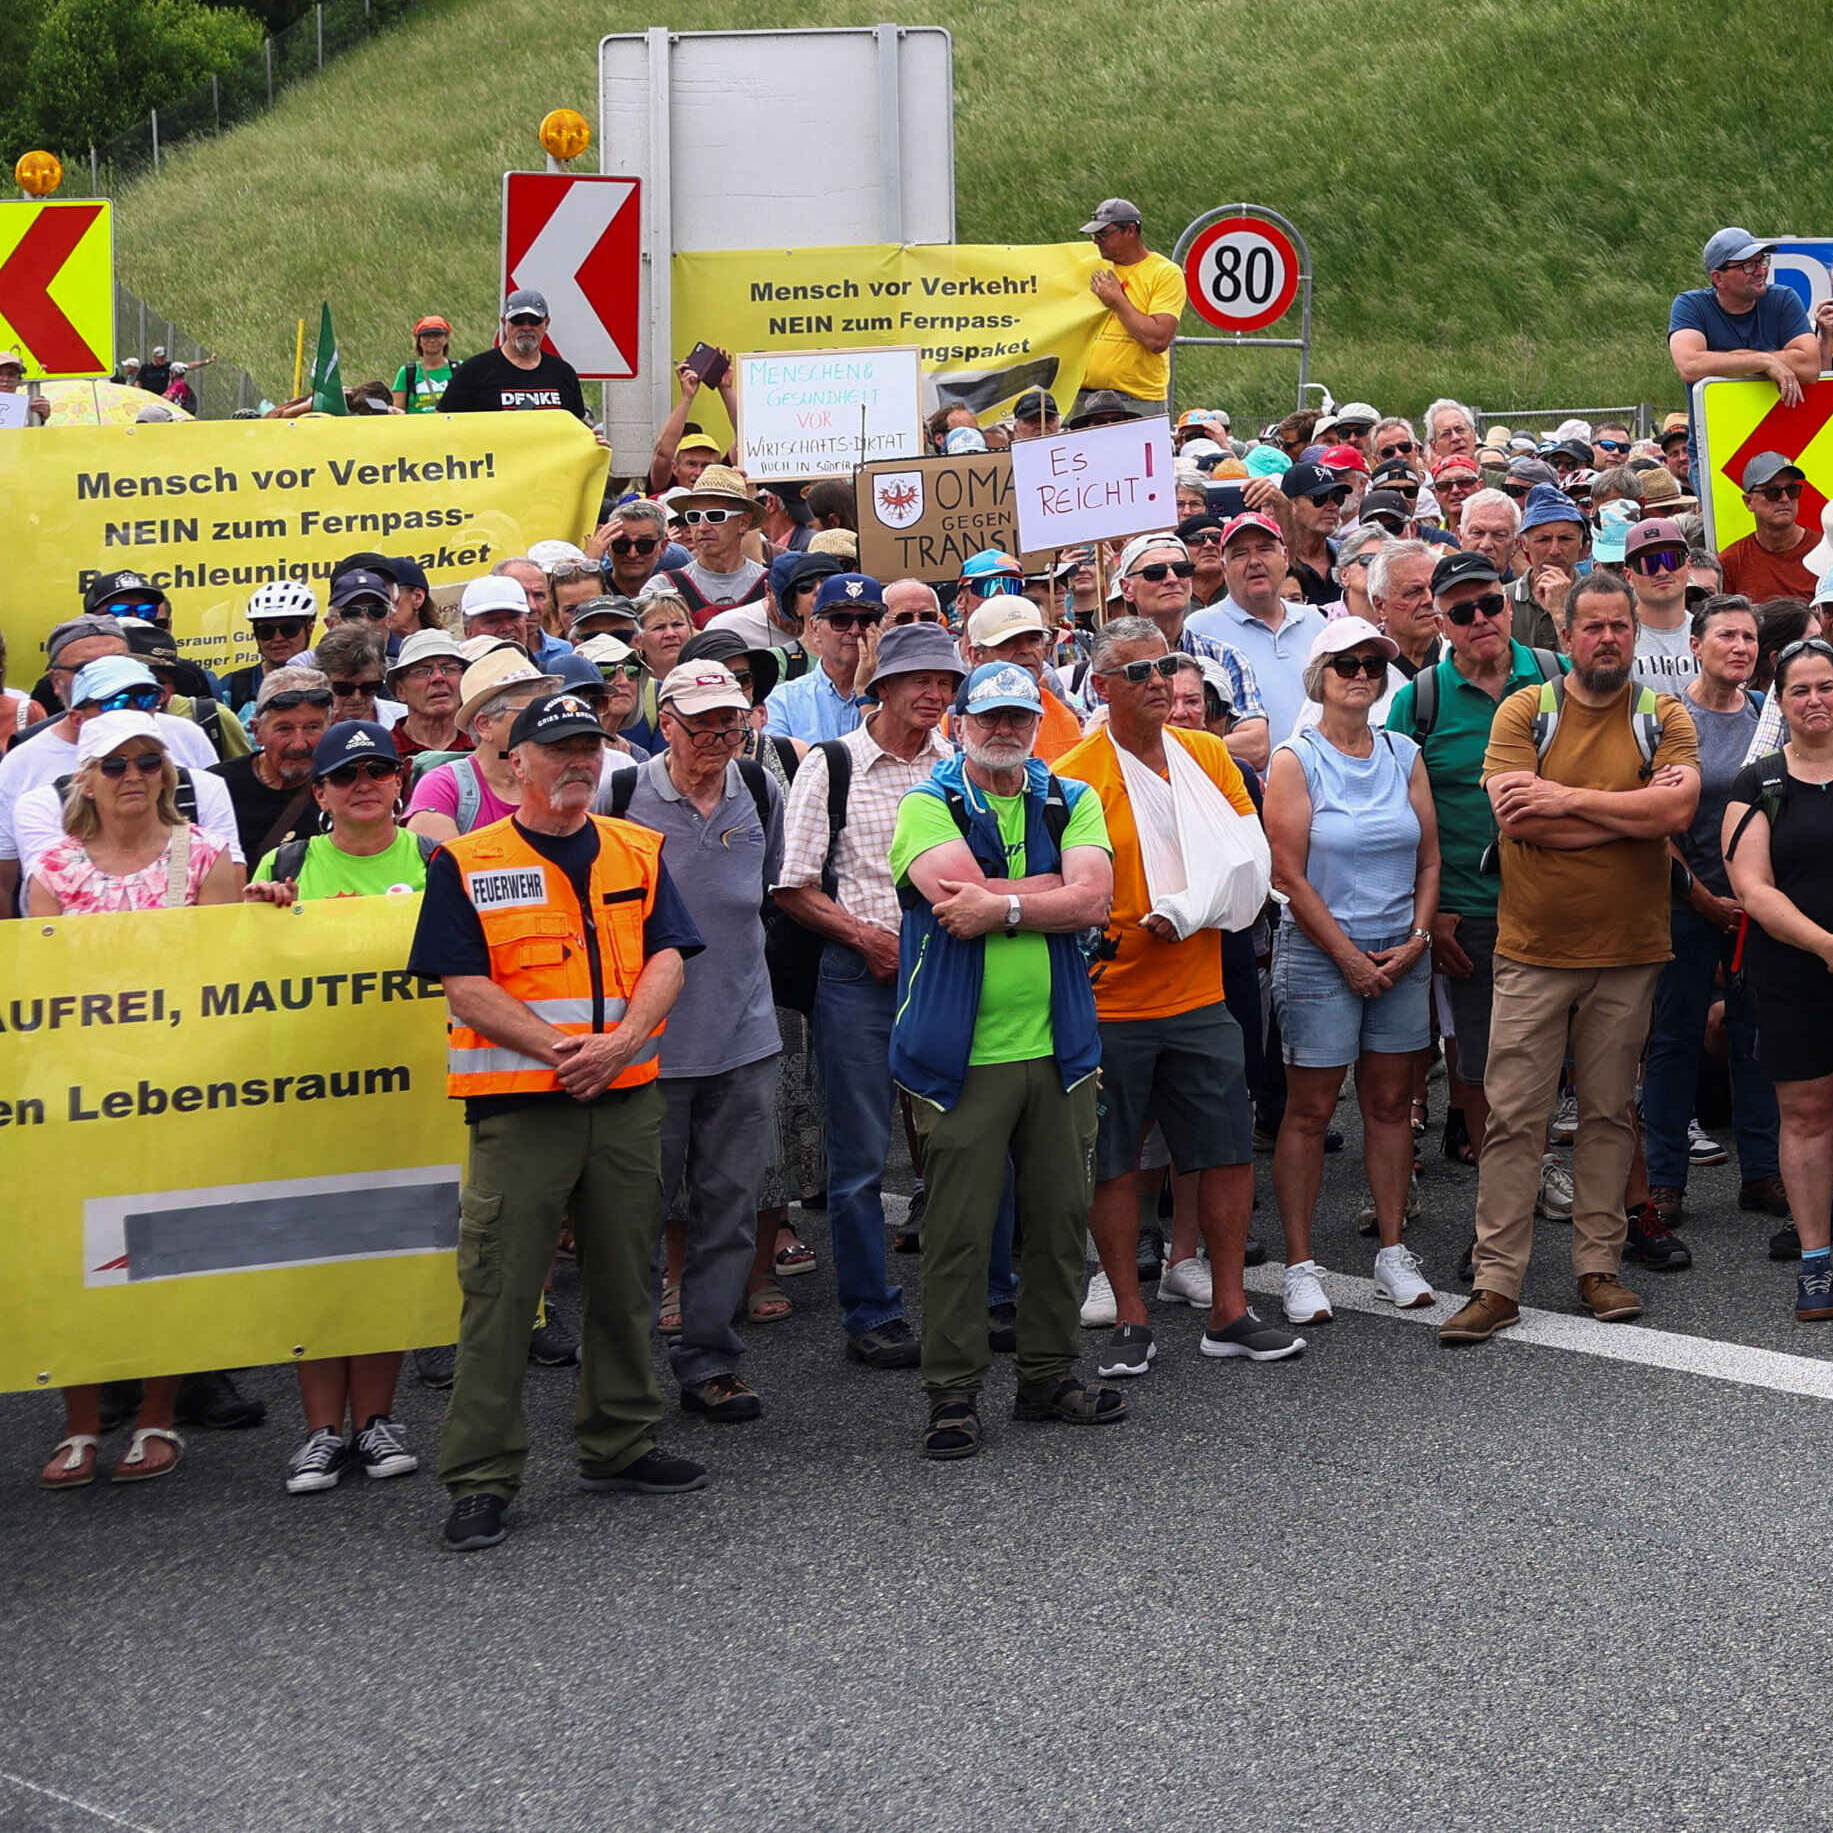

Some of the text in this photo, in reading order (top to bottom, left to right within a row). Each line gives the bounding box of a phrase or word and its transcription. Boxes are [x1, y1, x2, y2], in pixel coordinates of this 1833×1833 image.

[750, 275, 1038, 302] Mensch vor Verkehr!
[1212, 245, 1274, 304] 80
[769, 311, 1021, 335] NEIN zum Fernpass-
[796, 411, 833, 430] VOR
[77, 452, 496, 501] Mensch vor Verkehr!
[794, 461, 810, 472] IN
[105, 507, 475, 547] NEIN zum Fernpass-
[942, 510, 1012, 532] GEGEN
[471, 873, 543, 904] FEUERWEHR
[68, 1064, 411, 1123] Lebensraum
